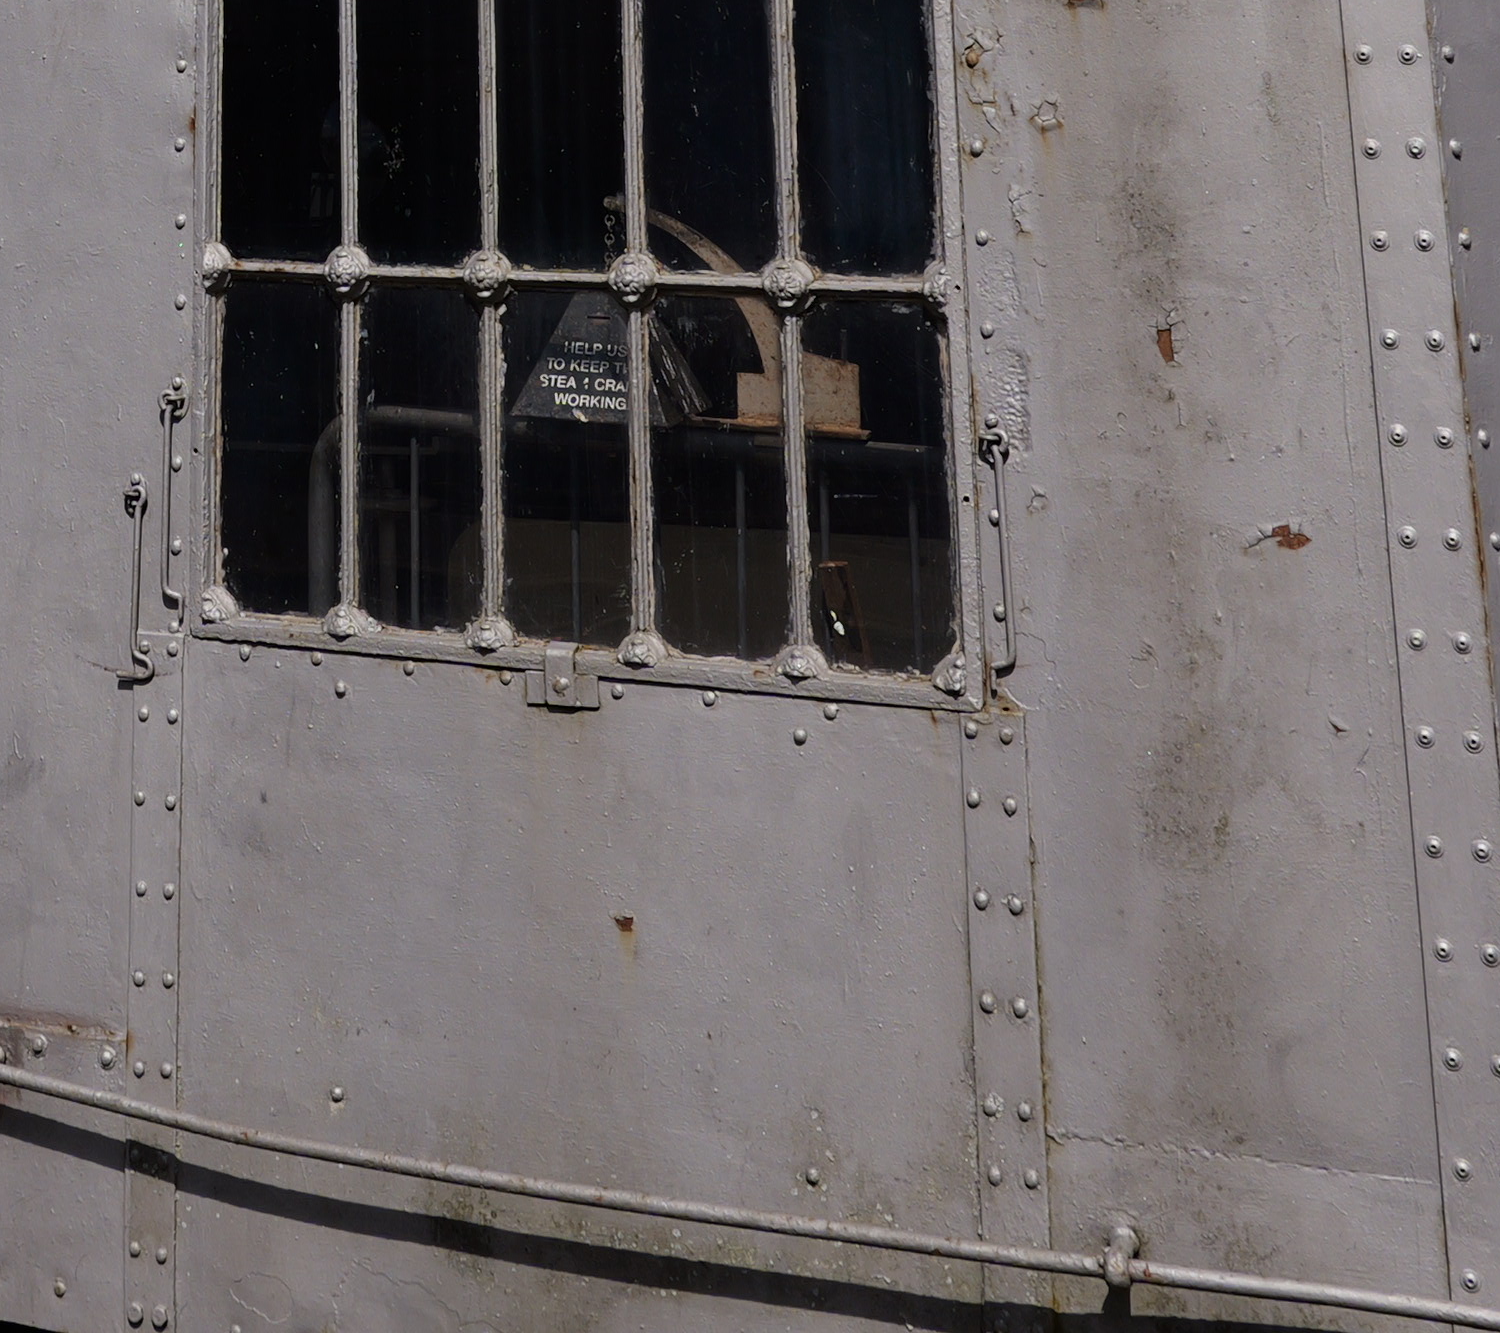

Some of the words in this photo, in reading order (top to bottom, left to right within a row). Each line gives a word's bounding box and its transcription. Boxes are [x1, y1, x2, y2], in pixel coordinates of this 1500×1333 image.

[564, 340, 603, 354] HELP
[607, 343, 629, 357] US
[546, 356, 566, 370] TO
[569, 359, 610, 373] KEEP
[554, 392, 627, 410] WORKING
